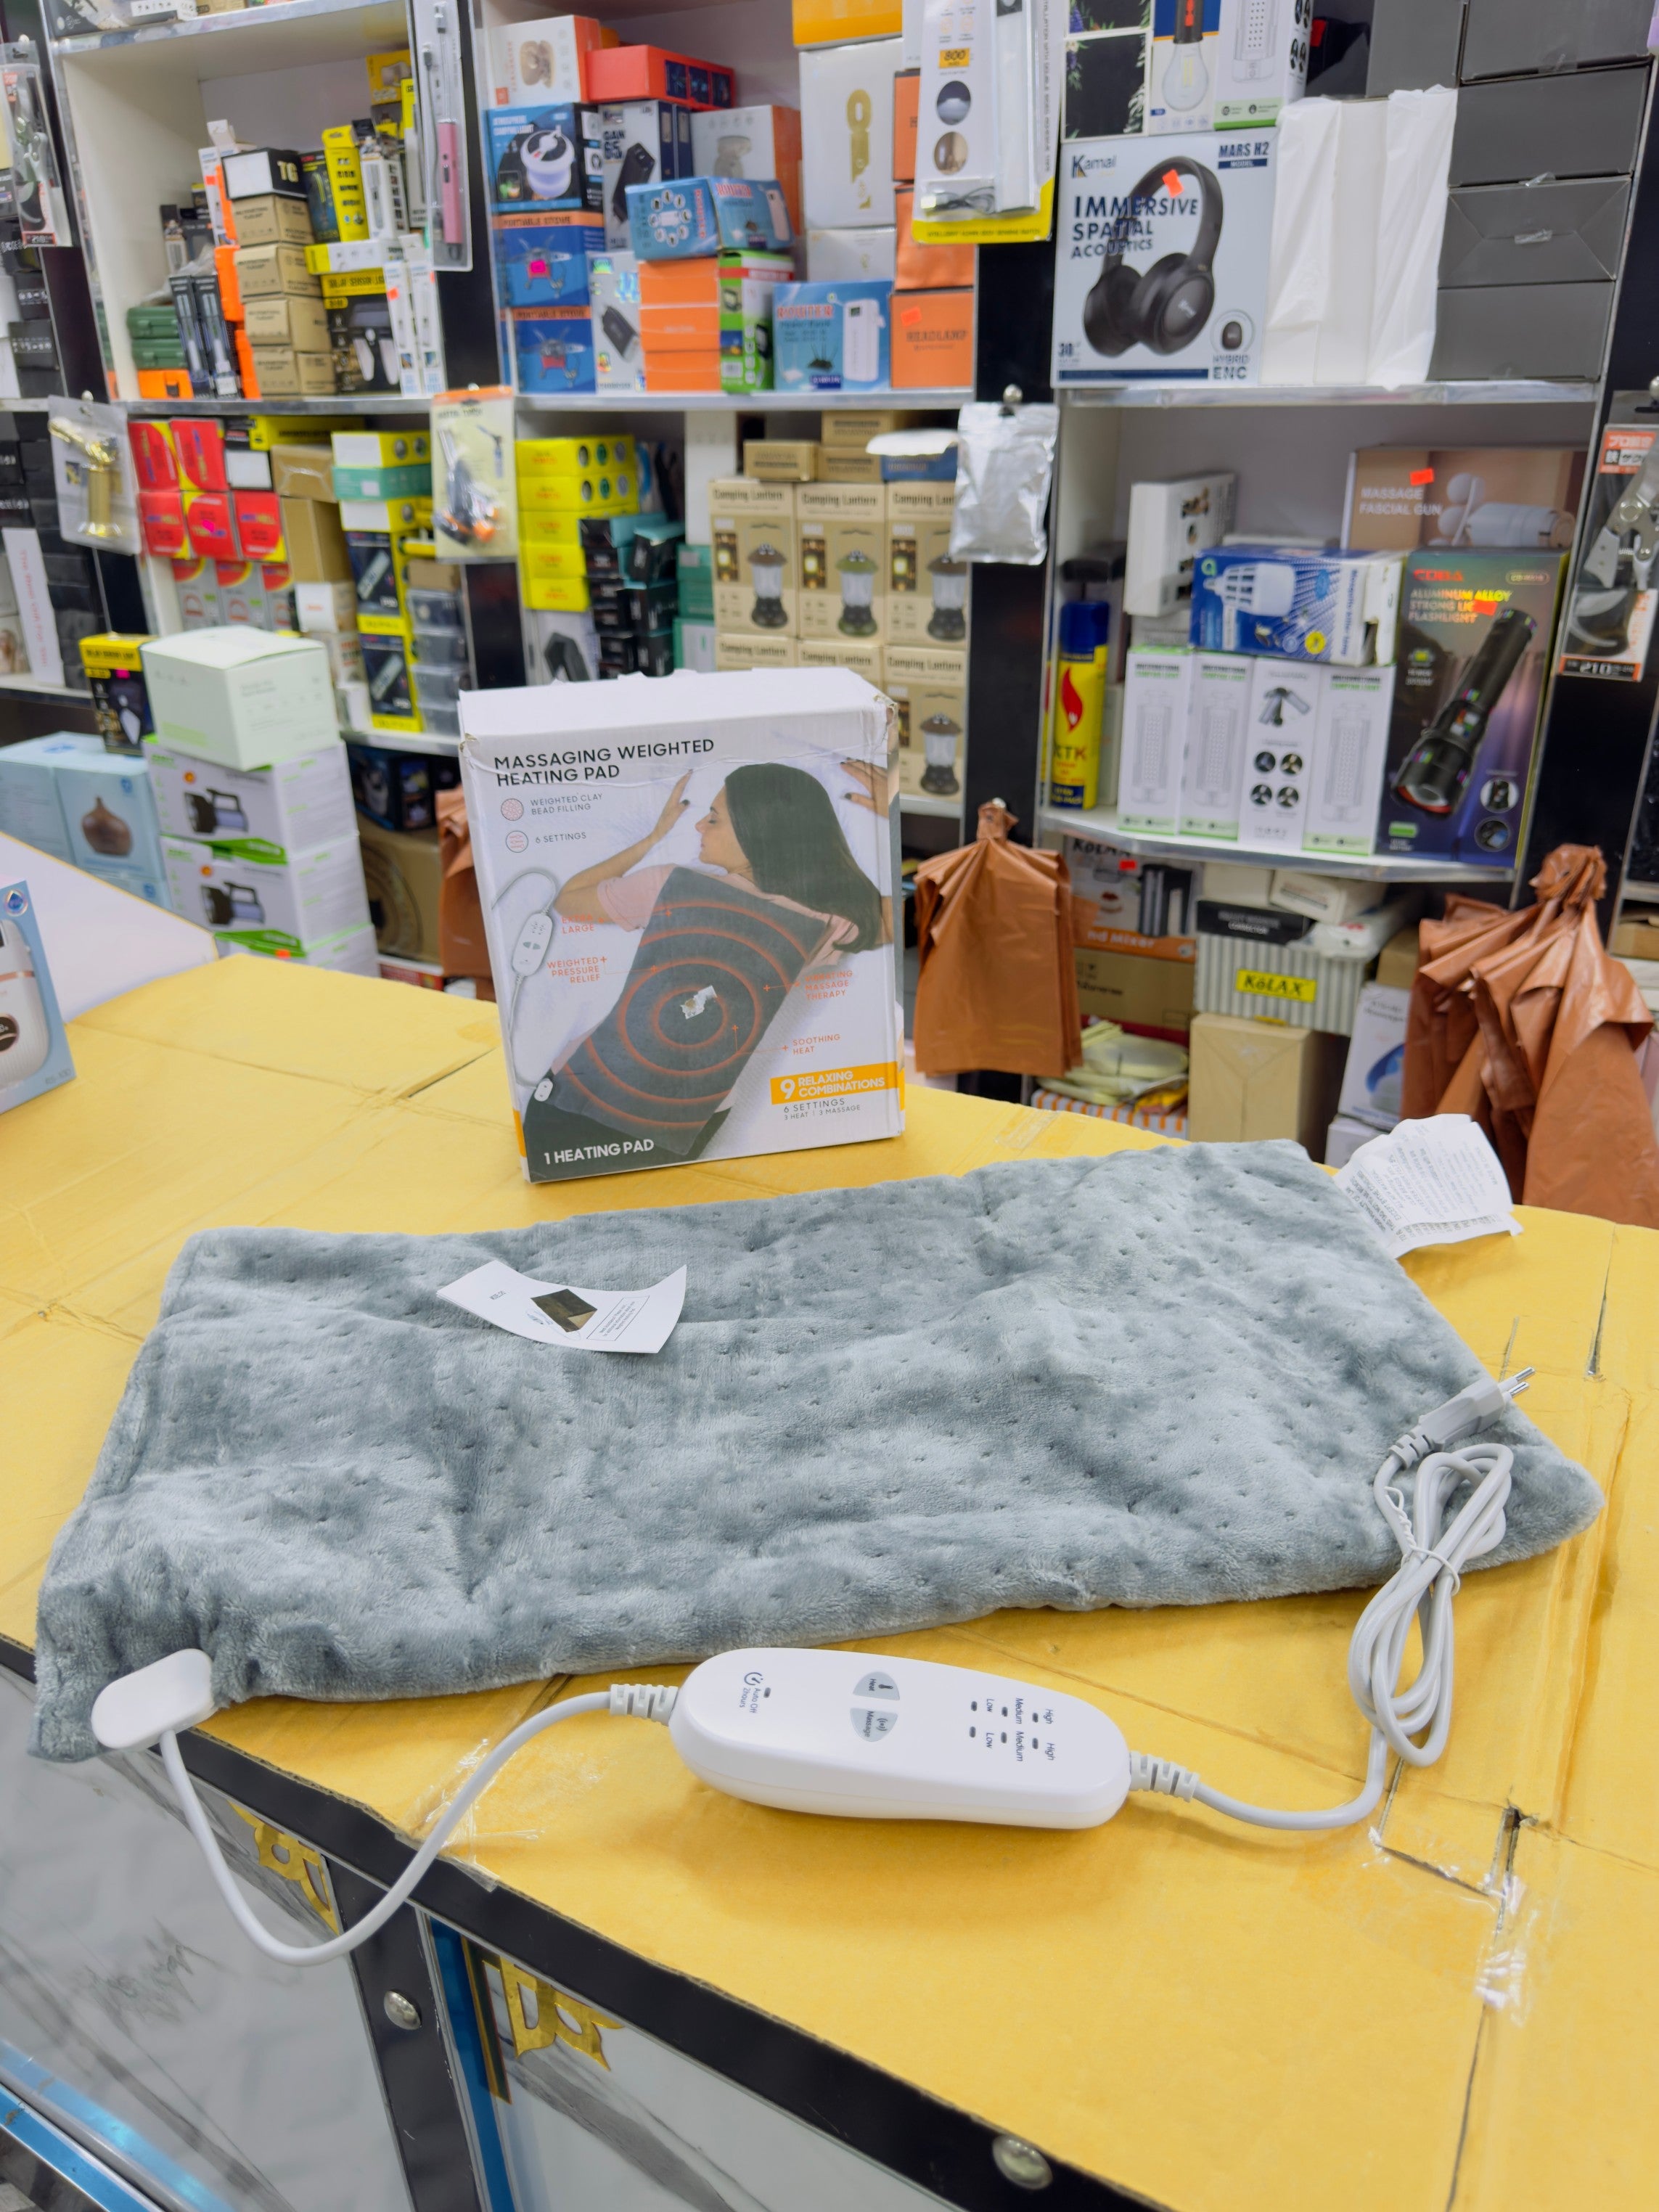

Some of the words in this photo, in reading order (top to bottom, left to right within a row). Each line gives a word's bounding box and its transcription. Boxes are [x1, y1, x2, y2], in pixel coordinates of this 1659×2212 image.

[1218, 144, 1251, 157] MARS
[277, 160, 298, 182] TG
[1074, 196, 1198, 218] IMMERSIVE
[1073, 220, 1153, 242] SPATIAL
[1071, 239, 1153, 259] ACOUSTICS
[1213, 366, 1247, 380] ENC
[713, 489, 747, 502] Camping
[802, 494, 838, 507] Camping
[894, 493, 932, 506] Camping
[1361, 487, 1424, 500] MASSAGE
[1474, 589, 1513, 602] ALLOY
[888, 656, 925, 670] Camping
[495, 748, 611, 769] MASSAGING
[618, 739, 714, 759] WEIGHTED
[496, 769, 578, 787] HEATING
[584, 765, 620, 780] PAD
[531, 795, 578, 806] WEIGHTED
[581, 793, 603, 803] CLAY
[531, 806, 555, 815] BEAD
[557, 803, 591, 813] FILLING
[544, 832, 587, 843] SETTINGS
[562, 923, 594, 934] LARGE
[1110, 933, 1155, 949] Mixer
[546, 957, 599, 969] WEIGHTED
[552, 966, 599, 977] PRESSURE
[805, 970, 853, 982] VIBRATING
[570, 975, 601, 983] RELIEF
[805, 980, 849, 991] MASSAGE
[806, 990, 845, 1001] THERAPY
[792, 1034, 841, 1046] SOOTHING
[792, 1046, 814, 1055] HEAT
[798, 1070, 853, 1087] RELAXING
[780, 1078, 795, 1099] 9
[799, 1077, 885, 1098] COMBINATIONS
[793, 1098, 845, 1112] SETTINGS
[825, 1105, 861, 1115] MASSAGE
[544, 1152, 551, 1165] 1
[554, 1143, 620, 1163] HEATING
[623, 1139, 655, 1154] PAD
[740, 1687, 751, 1708] 2hours
[752, 1687, 761, 1702] Auto
[750, 1703, 758, 1713] Off
[986, 1698, 995, 1713] Low
[1015, 1697, 1024, 1724] Medium
[1043, 1708, 1054, 1724] High
[863, 1711, 874, 1737] Massage
[986, 1732, 995, 1748] Low
[1015, 1731, 1025, 1762] Medium
[1044, 1742, 1055, 1761] High
